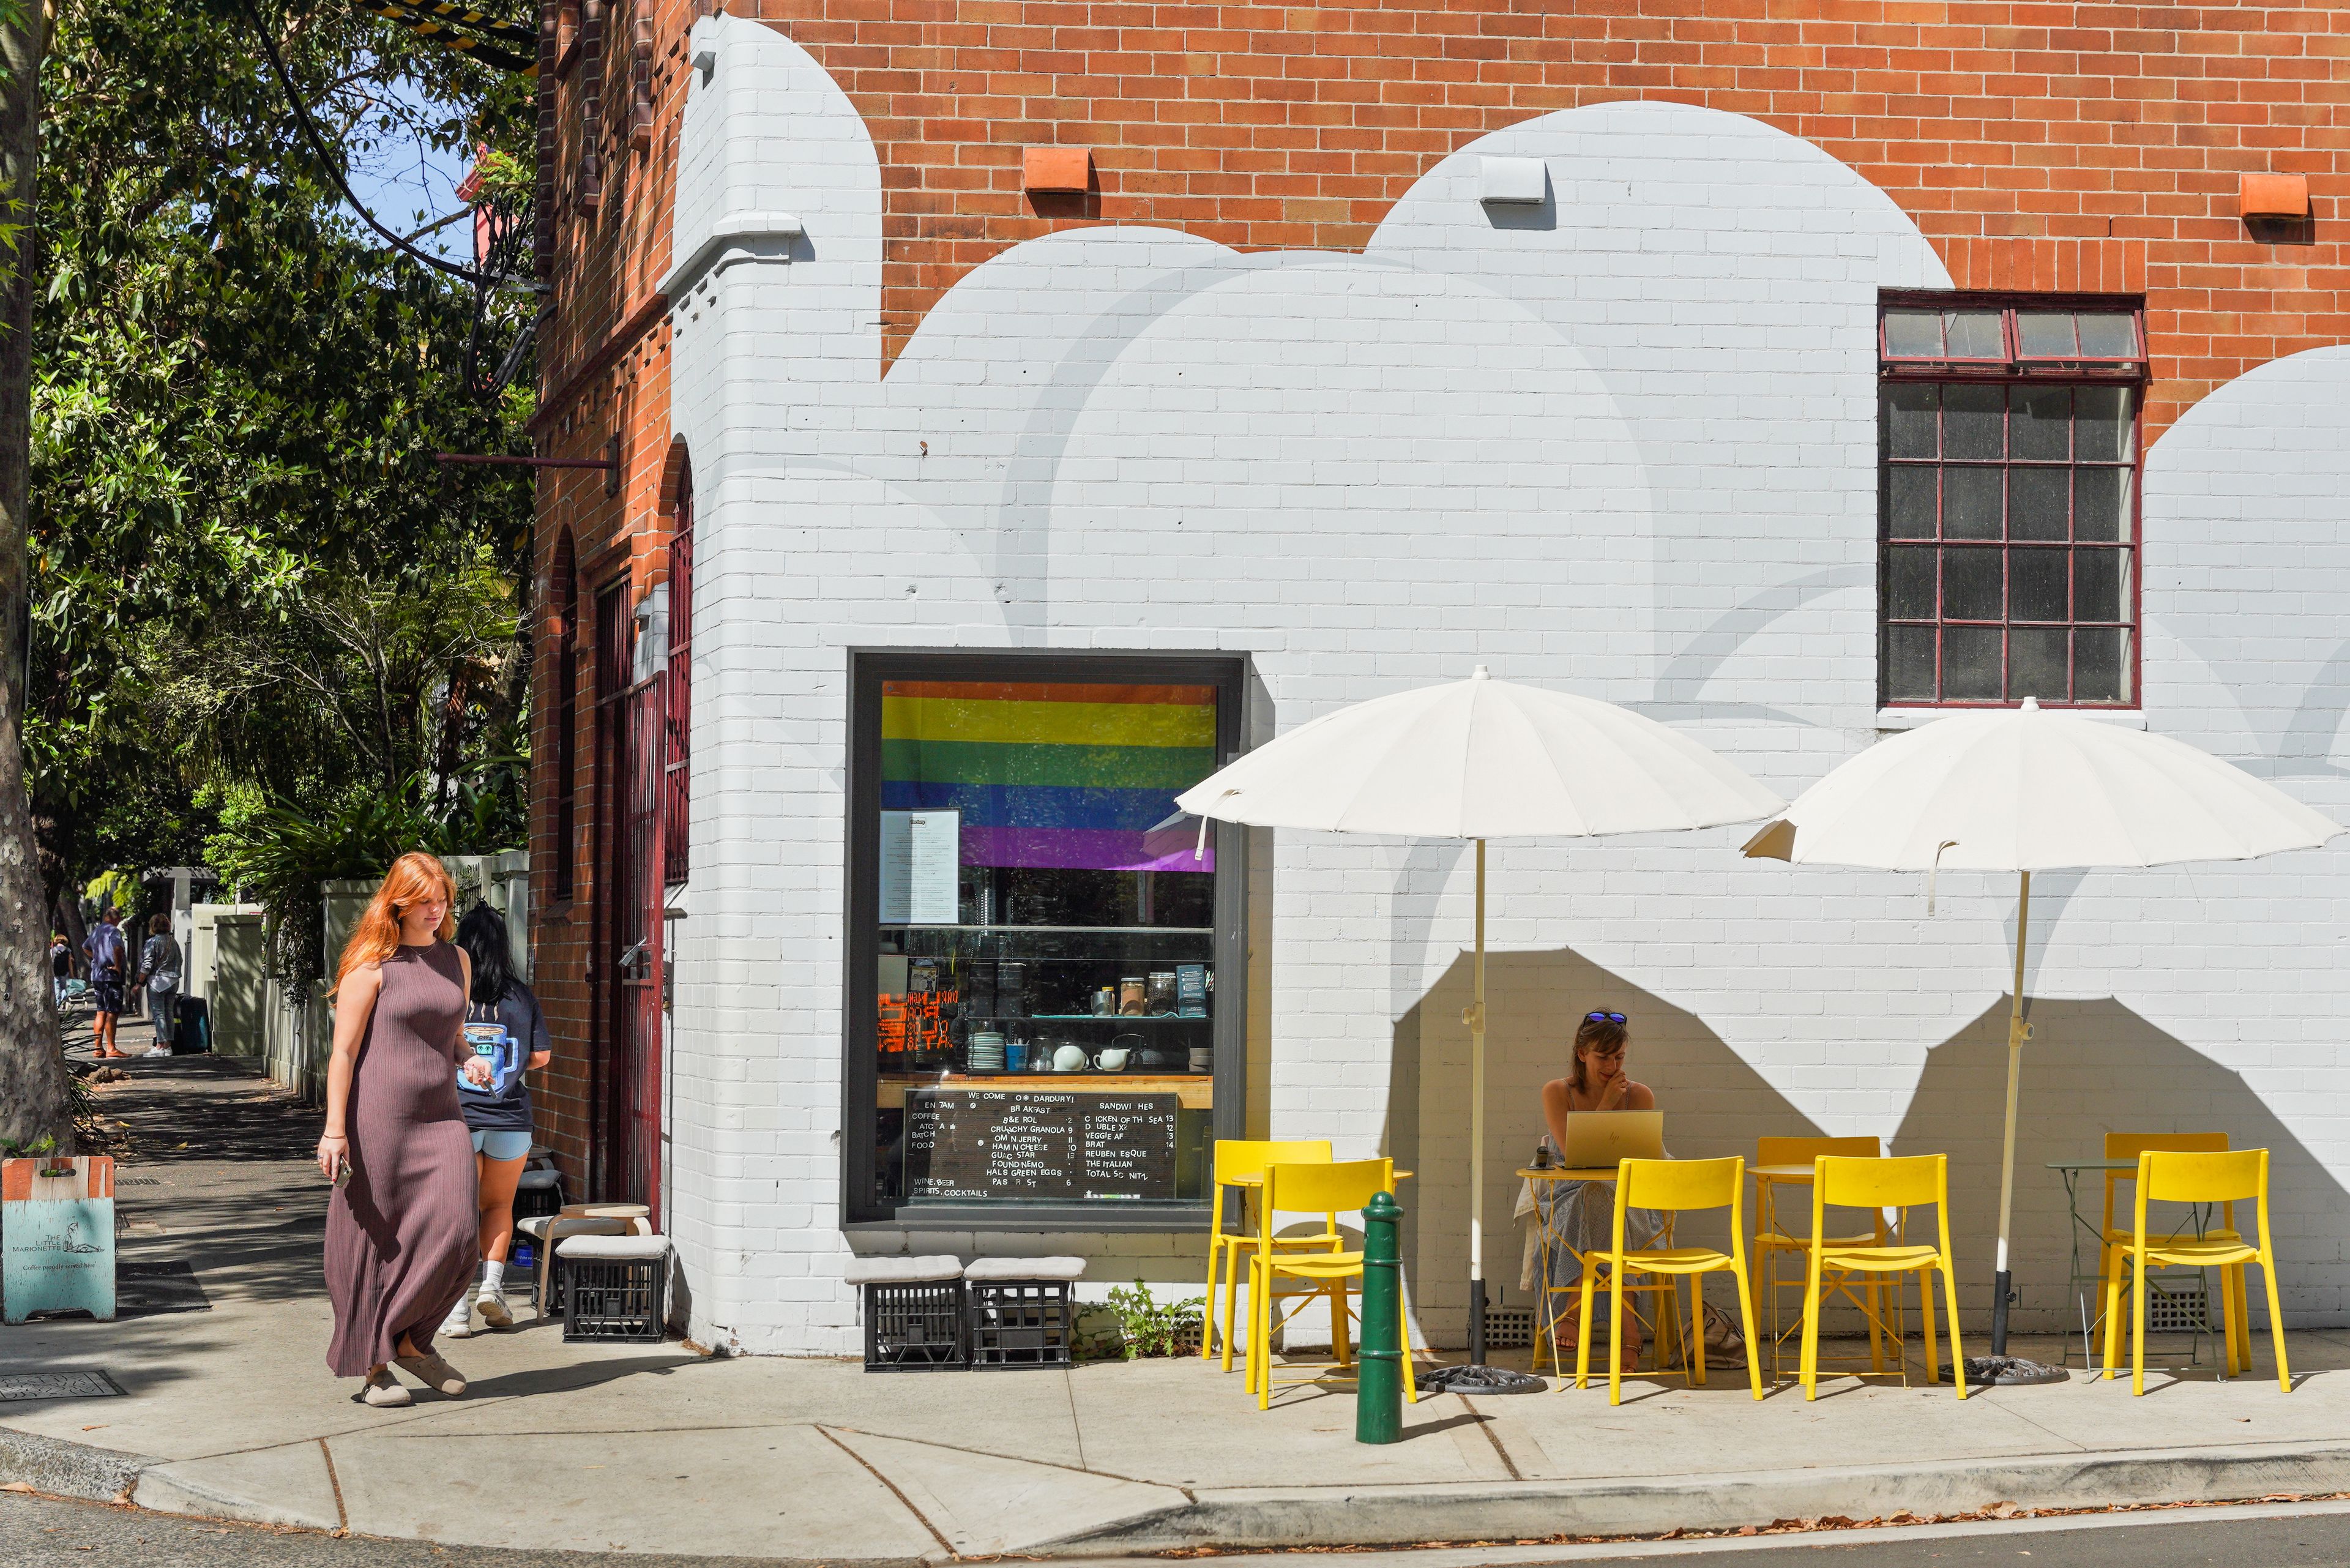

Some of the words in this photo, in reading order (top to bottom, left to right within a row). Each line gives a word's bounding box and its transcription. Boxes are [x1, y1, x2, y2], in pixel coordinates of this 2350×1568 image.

[1149, 1116, 1163, 1124] SEA
[912, 1130, 935, 1139] BATCH
[1121, 1149, 1146, 1158] ESQUE
[1086, 1170, 1111, 1178] TOTAL
